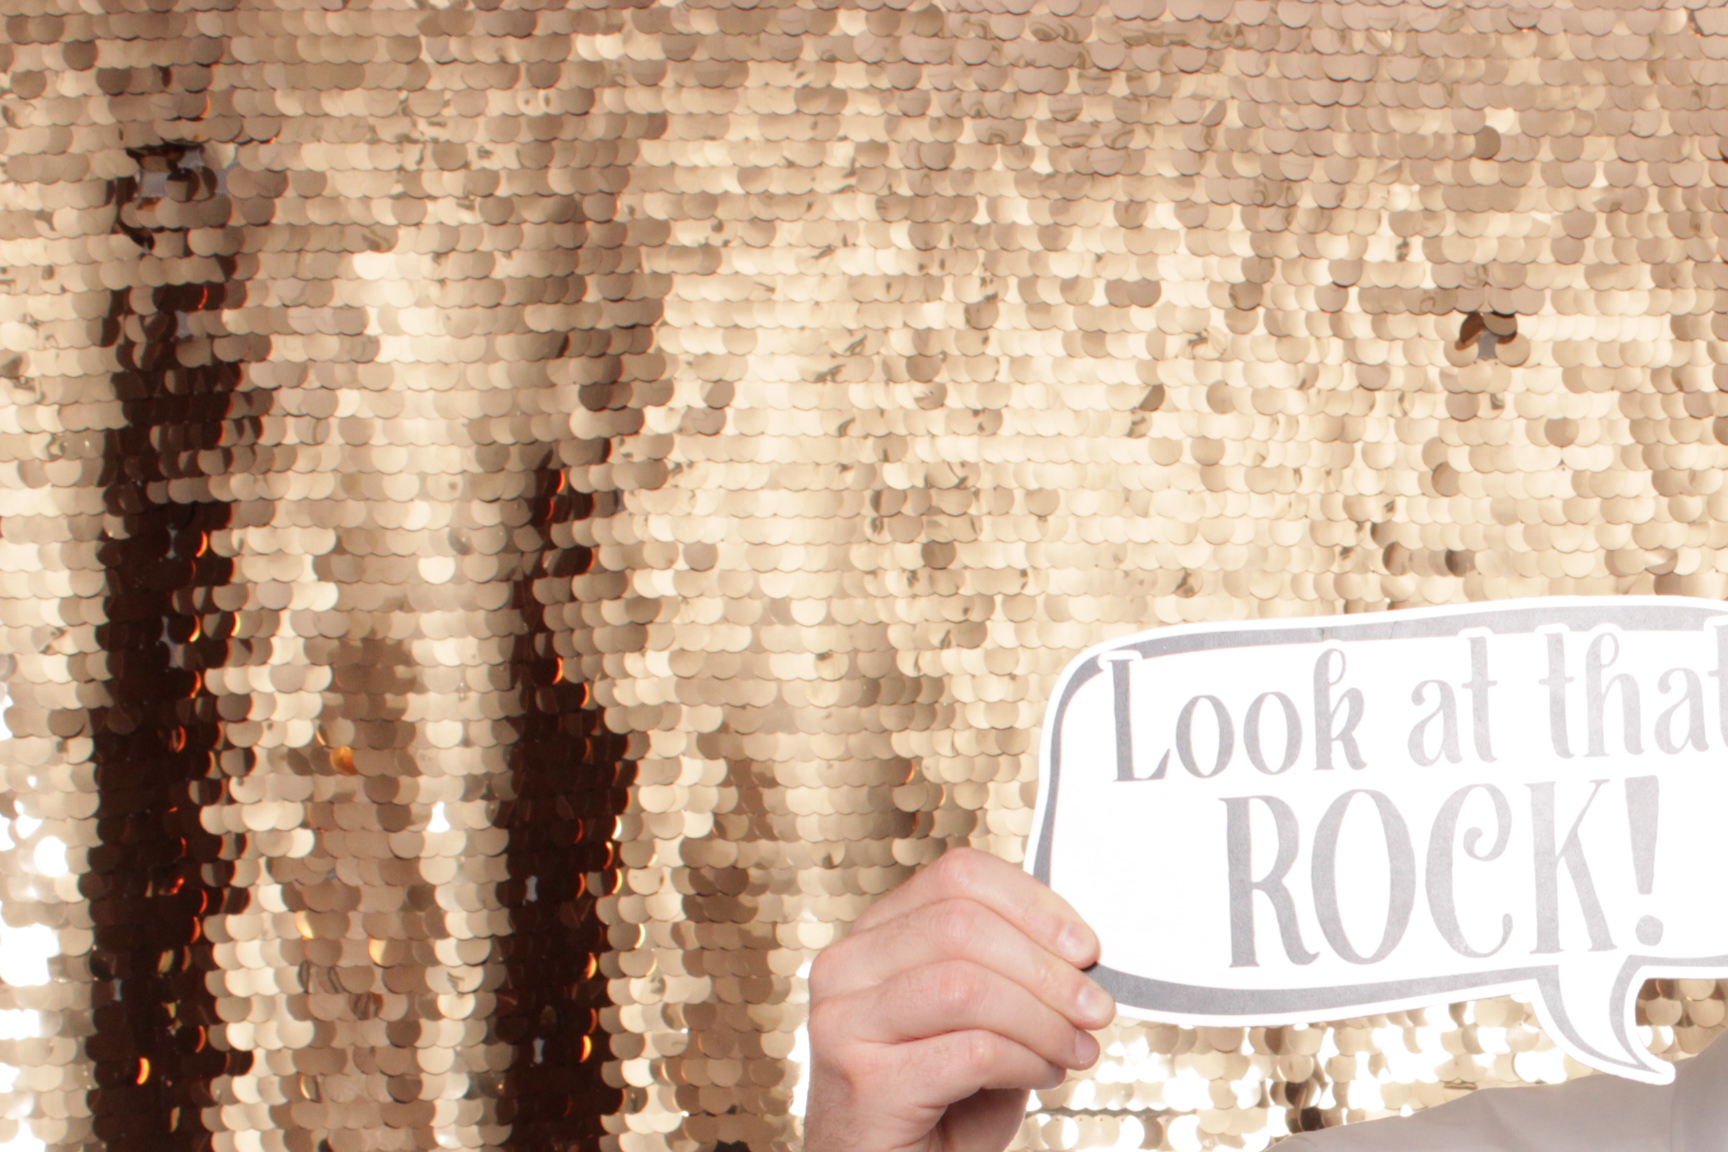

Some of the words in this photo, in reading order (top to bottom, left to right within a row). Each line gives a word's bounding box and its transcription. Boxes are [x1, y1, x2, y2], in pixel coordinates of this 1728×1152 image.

[1109, 646, 1367, 782] Look
[1407, 636, 1498, 767] at
[1218, 775, 1664, 968] ROCK!
